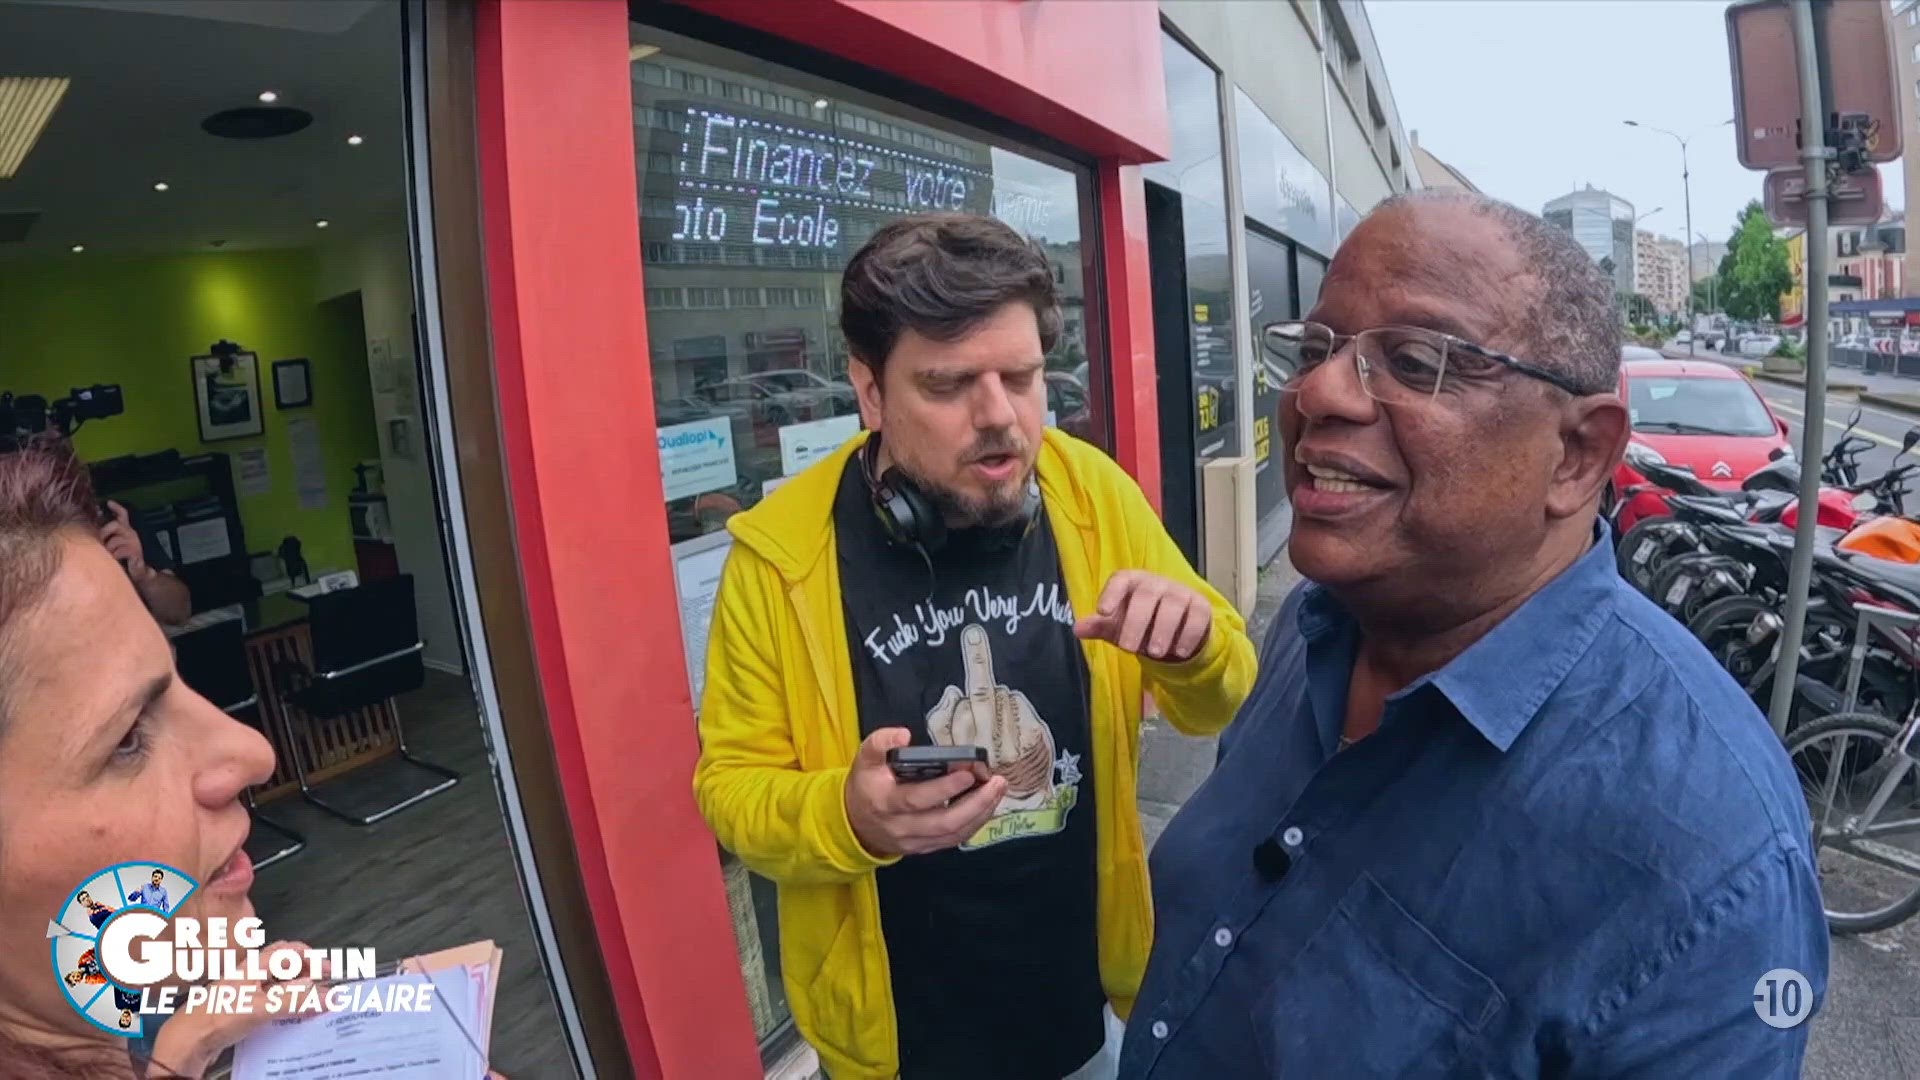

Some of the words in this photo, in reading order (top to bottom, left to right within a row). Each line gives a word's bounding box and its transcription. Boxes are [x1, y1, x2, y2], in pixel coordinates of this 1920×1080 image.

[701, 116, 876, 197] Financez
[905, 169, 968, 210] votre
[752, 198, 839, 248] Ecole
[864, 613, 919, 664] Fuck
[915, 604, 964, 646] You
[965, 586, 1021, 635] Very
